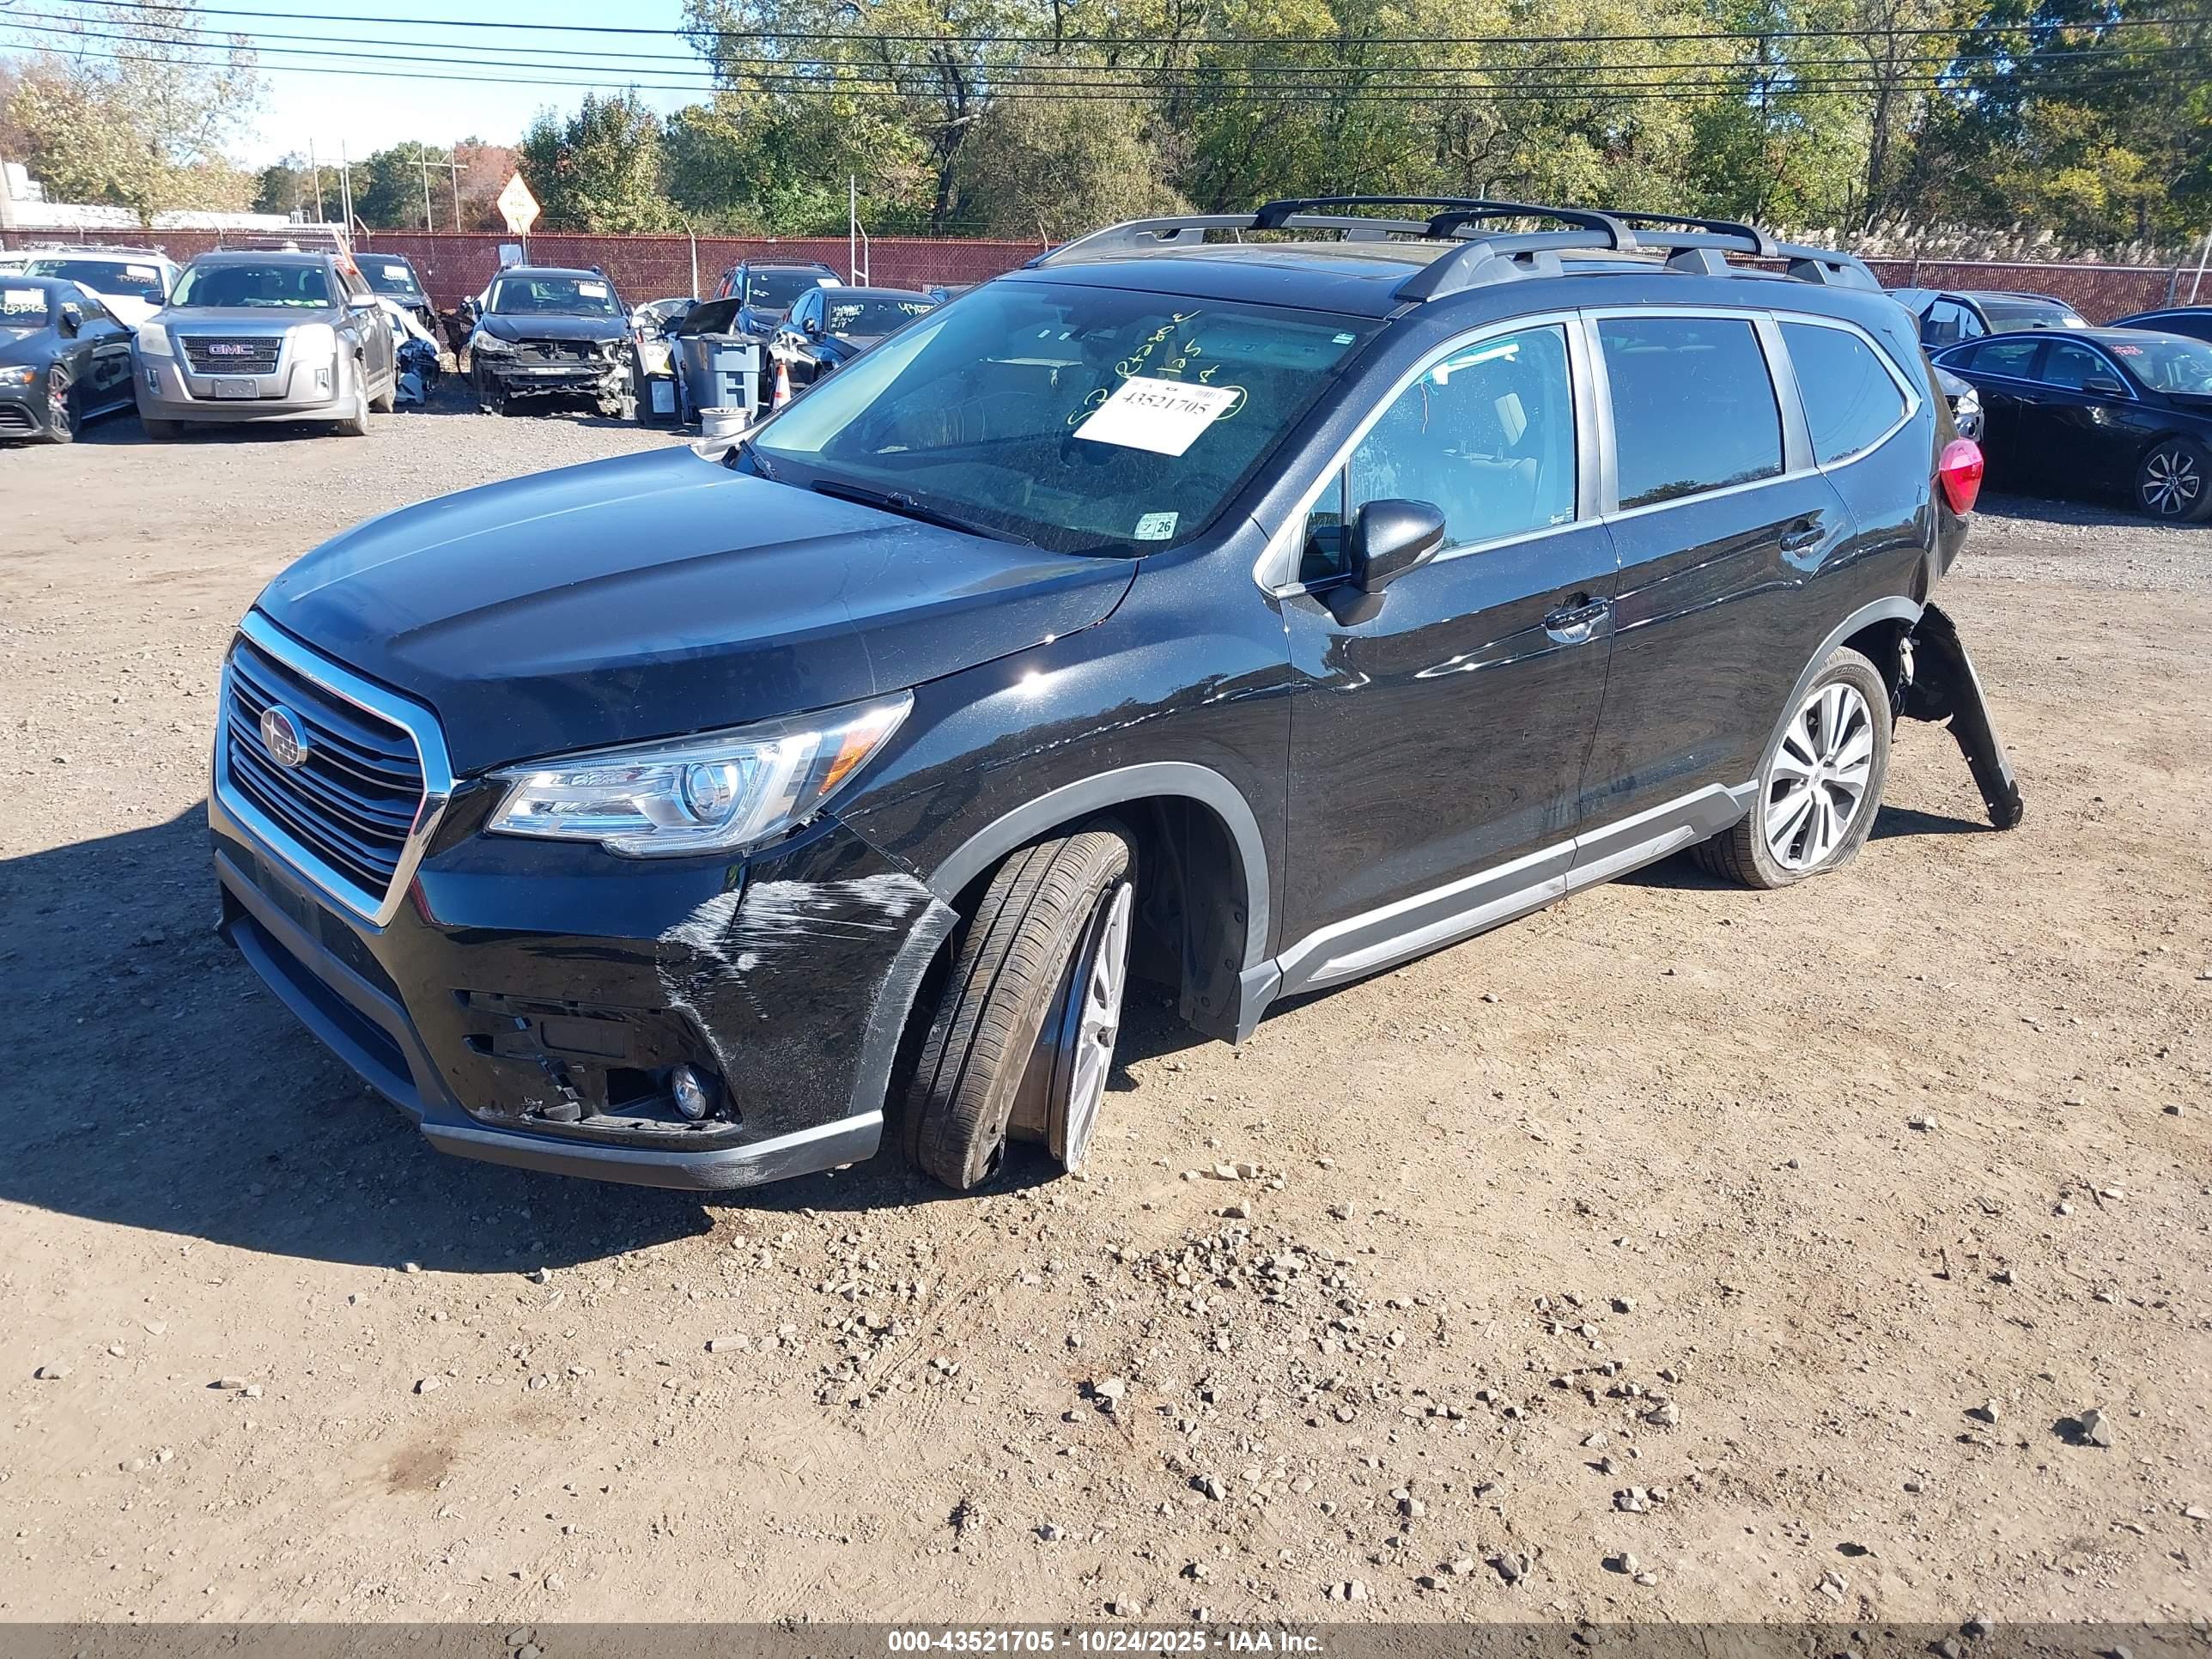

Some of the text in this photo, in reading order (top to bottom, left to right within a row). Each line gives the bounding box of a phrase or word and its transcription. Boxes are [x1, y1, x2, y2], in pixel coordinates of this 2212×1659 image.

[209, 343, 255, 355] GMC
[1122, 392, 1211, 416] 43521705
[1157, 520, 1171, 532] 26
[1037, 904, 1086, 1011] ADVENTURER
